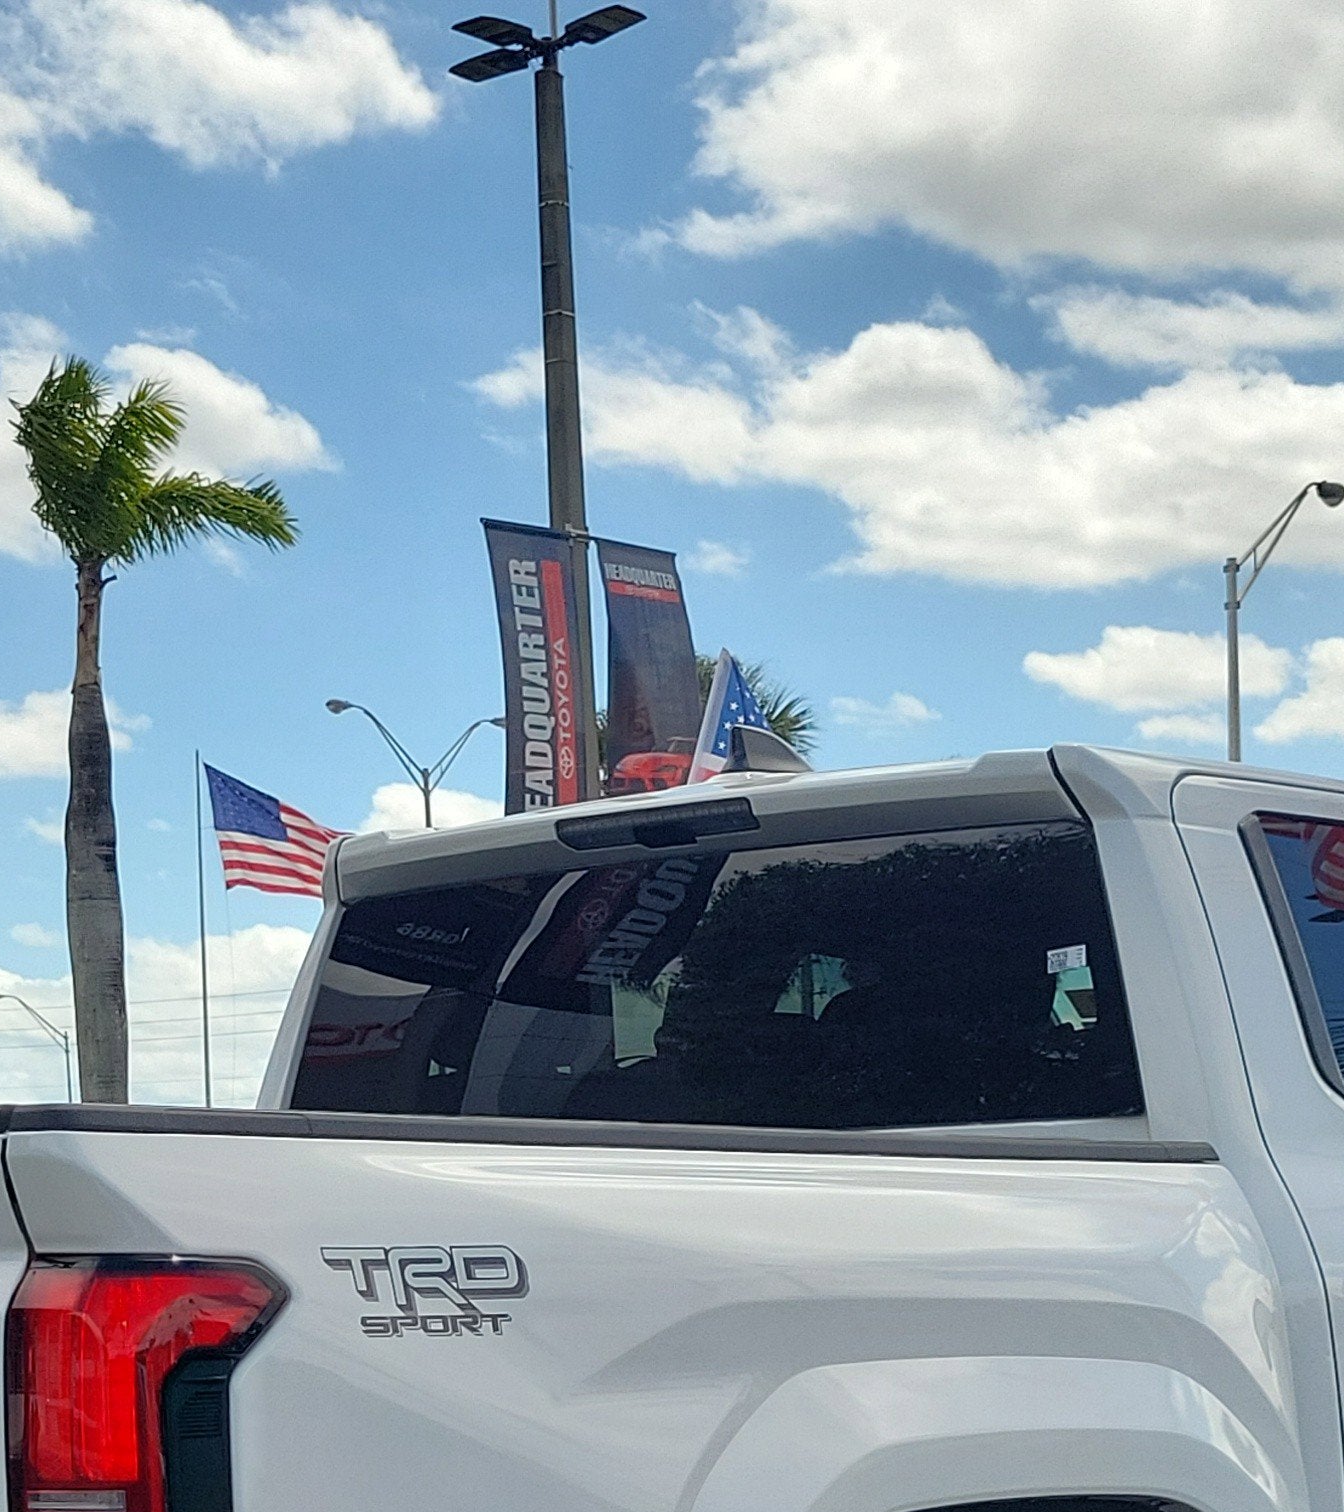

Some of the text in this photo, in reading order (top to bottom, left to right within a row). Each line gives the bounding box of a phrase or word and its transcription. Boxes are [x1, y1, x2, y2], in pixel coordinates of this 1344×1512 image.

[508, 558, 555, 812] EADQUARTER
[553, 637, 573, 742] TOYOTA
[320, 1244, 529, 1316] TRD
[360, 1313, 512, 1337] SPORT
